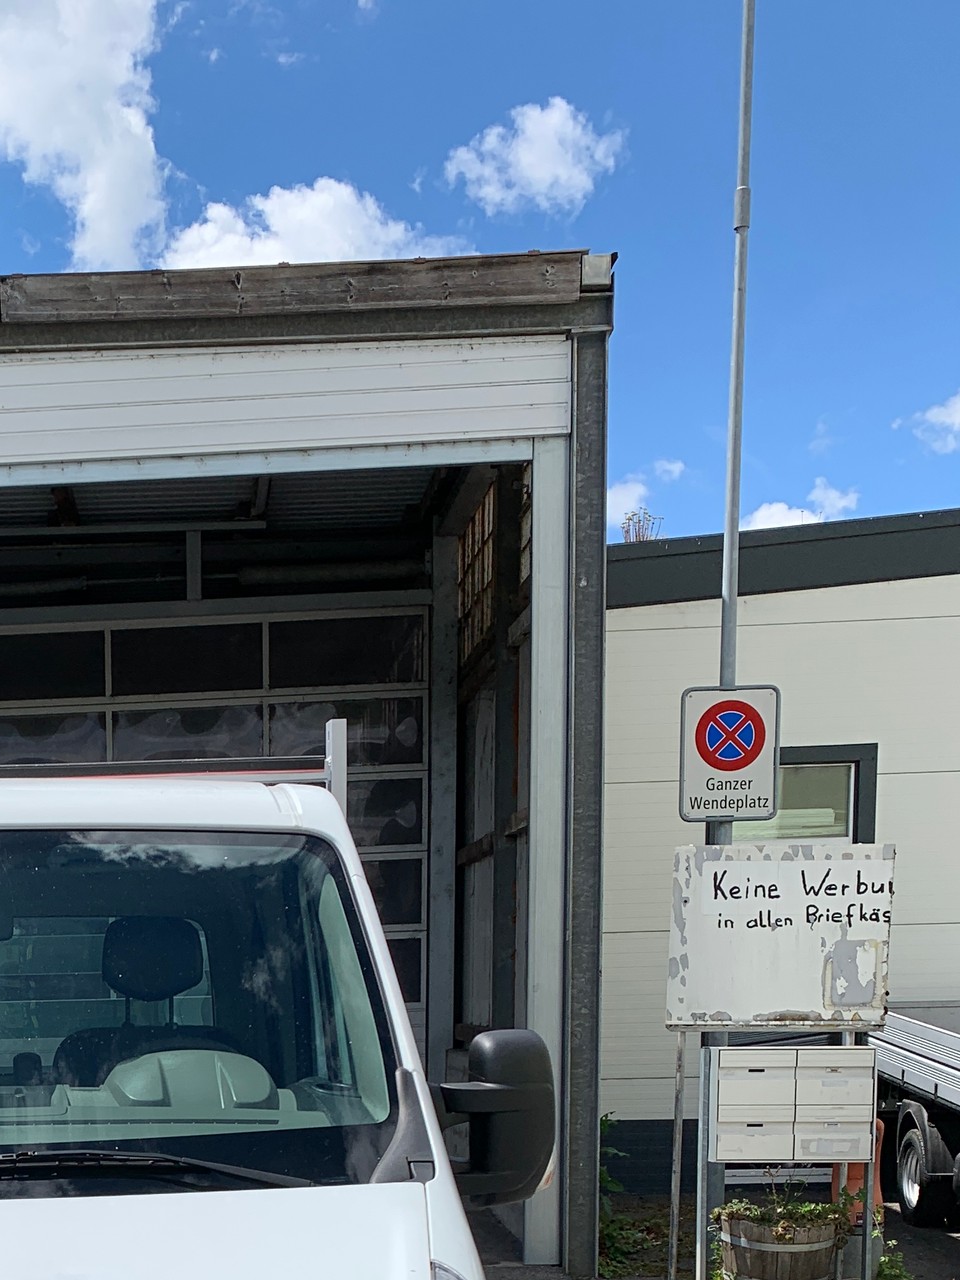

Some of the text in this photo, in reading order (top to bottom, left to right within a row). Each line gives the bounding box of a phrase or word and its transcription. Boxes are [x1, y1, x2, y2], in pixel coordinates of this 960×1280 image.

[706, 777, 753, 791] Ganzer
[689, 794, 769, 813] Wendeplatz
[713, 869, 781, 901] Keine
[717, 912, 735, 929] in
[746, 909, 793, 929] allen
